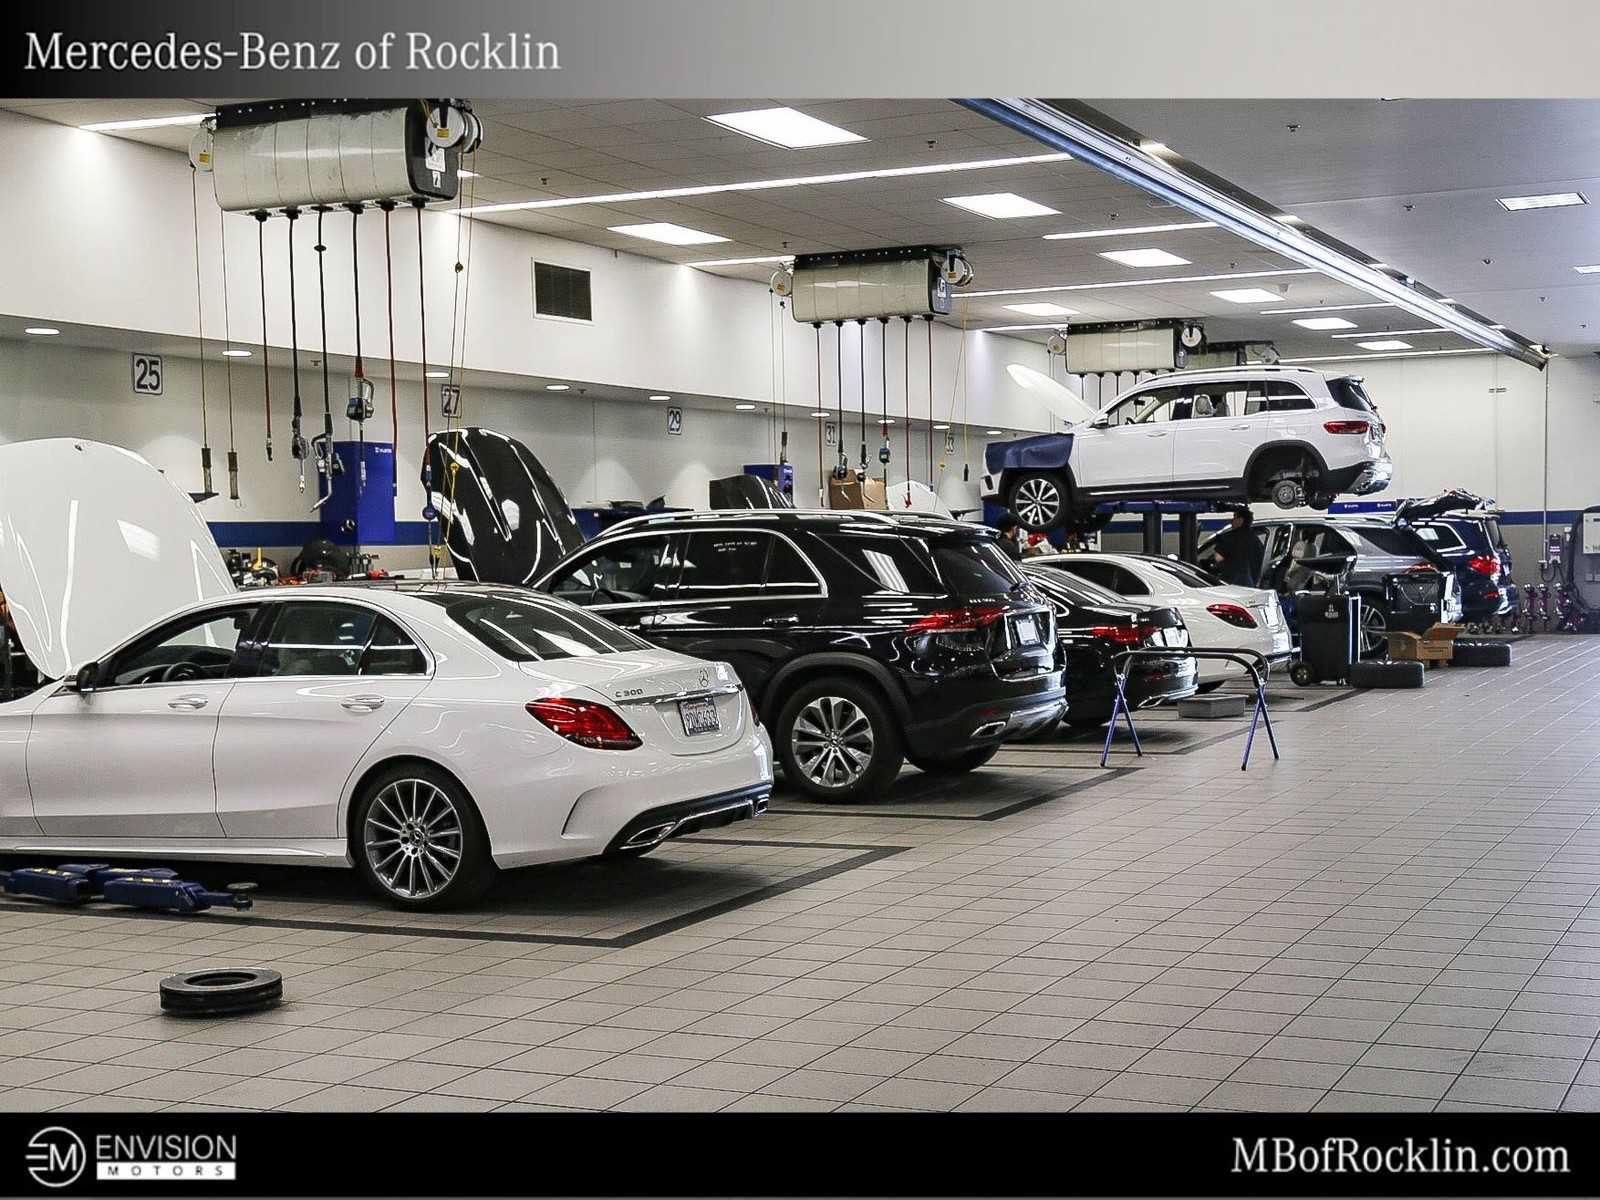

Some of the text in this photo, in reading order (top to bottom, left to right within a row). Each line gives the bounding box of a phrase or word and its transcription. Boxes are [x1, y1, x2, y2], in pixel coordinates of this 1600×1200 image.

[135, 357, 161, 391] 25
[441, 387, 461, 415] 27
[669, 409, 681, 432] 29
[826, 424, 836, 444] 31
[624, 688, 643, 697] 300
